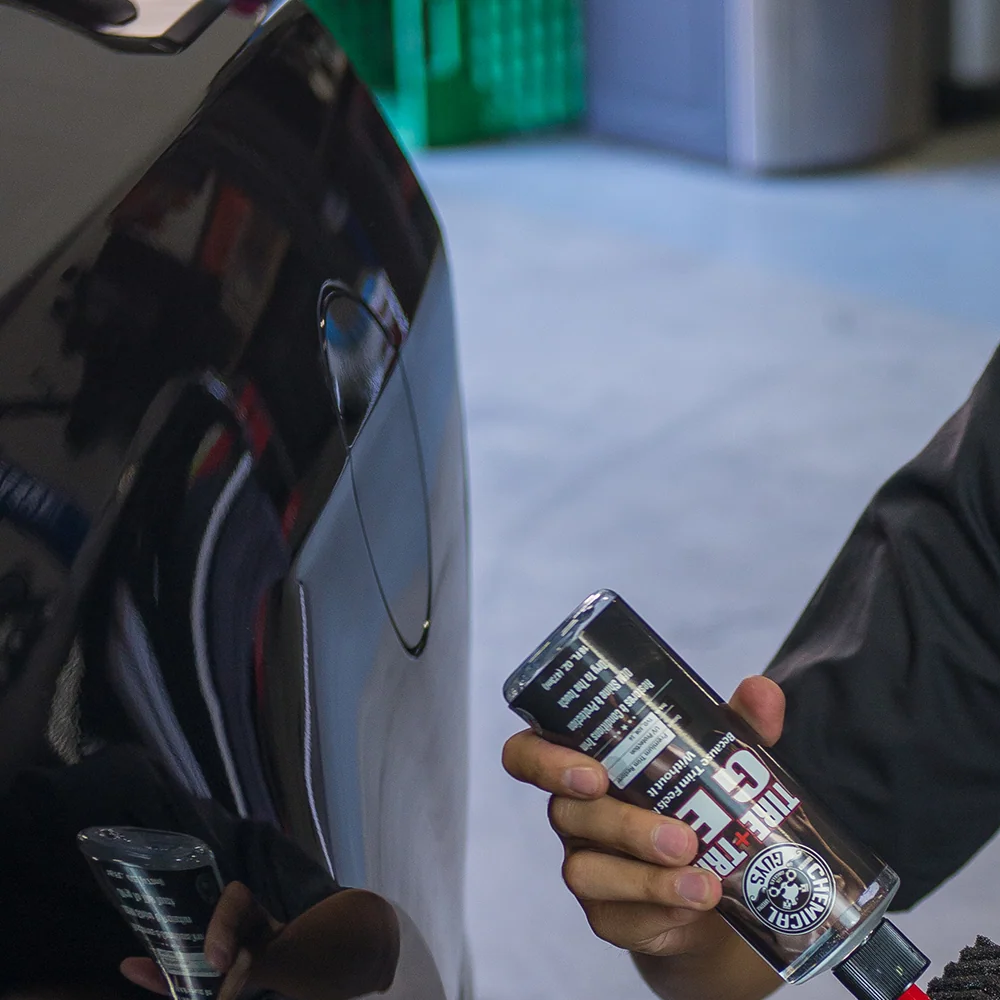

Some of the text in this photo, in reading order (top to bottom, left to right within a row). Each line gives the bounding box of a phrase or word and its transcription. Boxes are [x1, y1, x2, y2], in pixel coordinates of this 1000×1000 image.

[555, 658, 609, 708] Dry To The Touch
[597, 677, 622, 700] Shine
[622, 677, 655, 708] Restores
[565, 699, 600, 732] Protection
[588, 707, 625, 742] Conditions
[578, 735, 597, 752] Trim
[628, 731, 653, 756] Protection
[642, 731, 668, 756] Premium
[631, 754, 646, 767] Trim
[645, 750, 696, 798] Without It
[655, 730, 736, 811] Because Trim Feels
[674, 749, 770, 844] GE
[750, 851, 783, 885] GUYS
[767, 861, 830, 927] CHEMICAL
